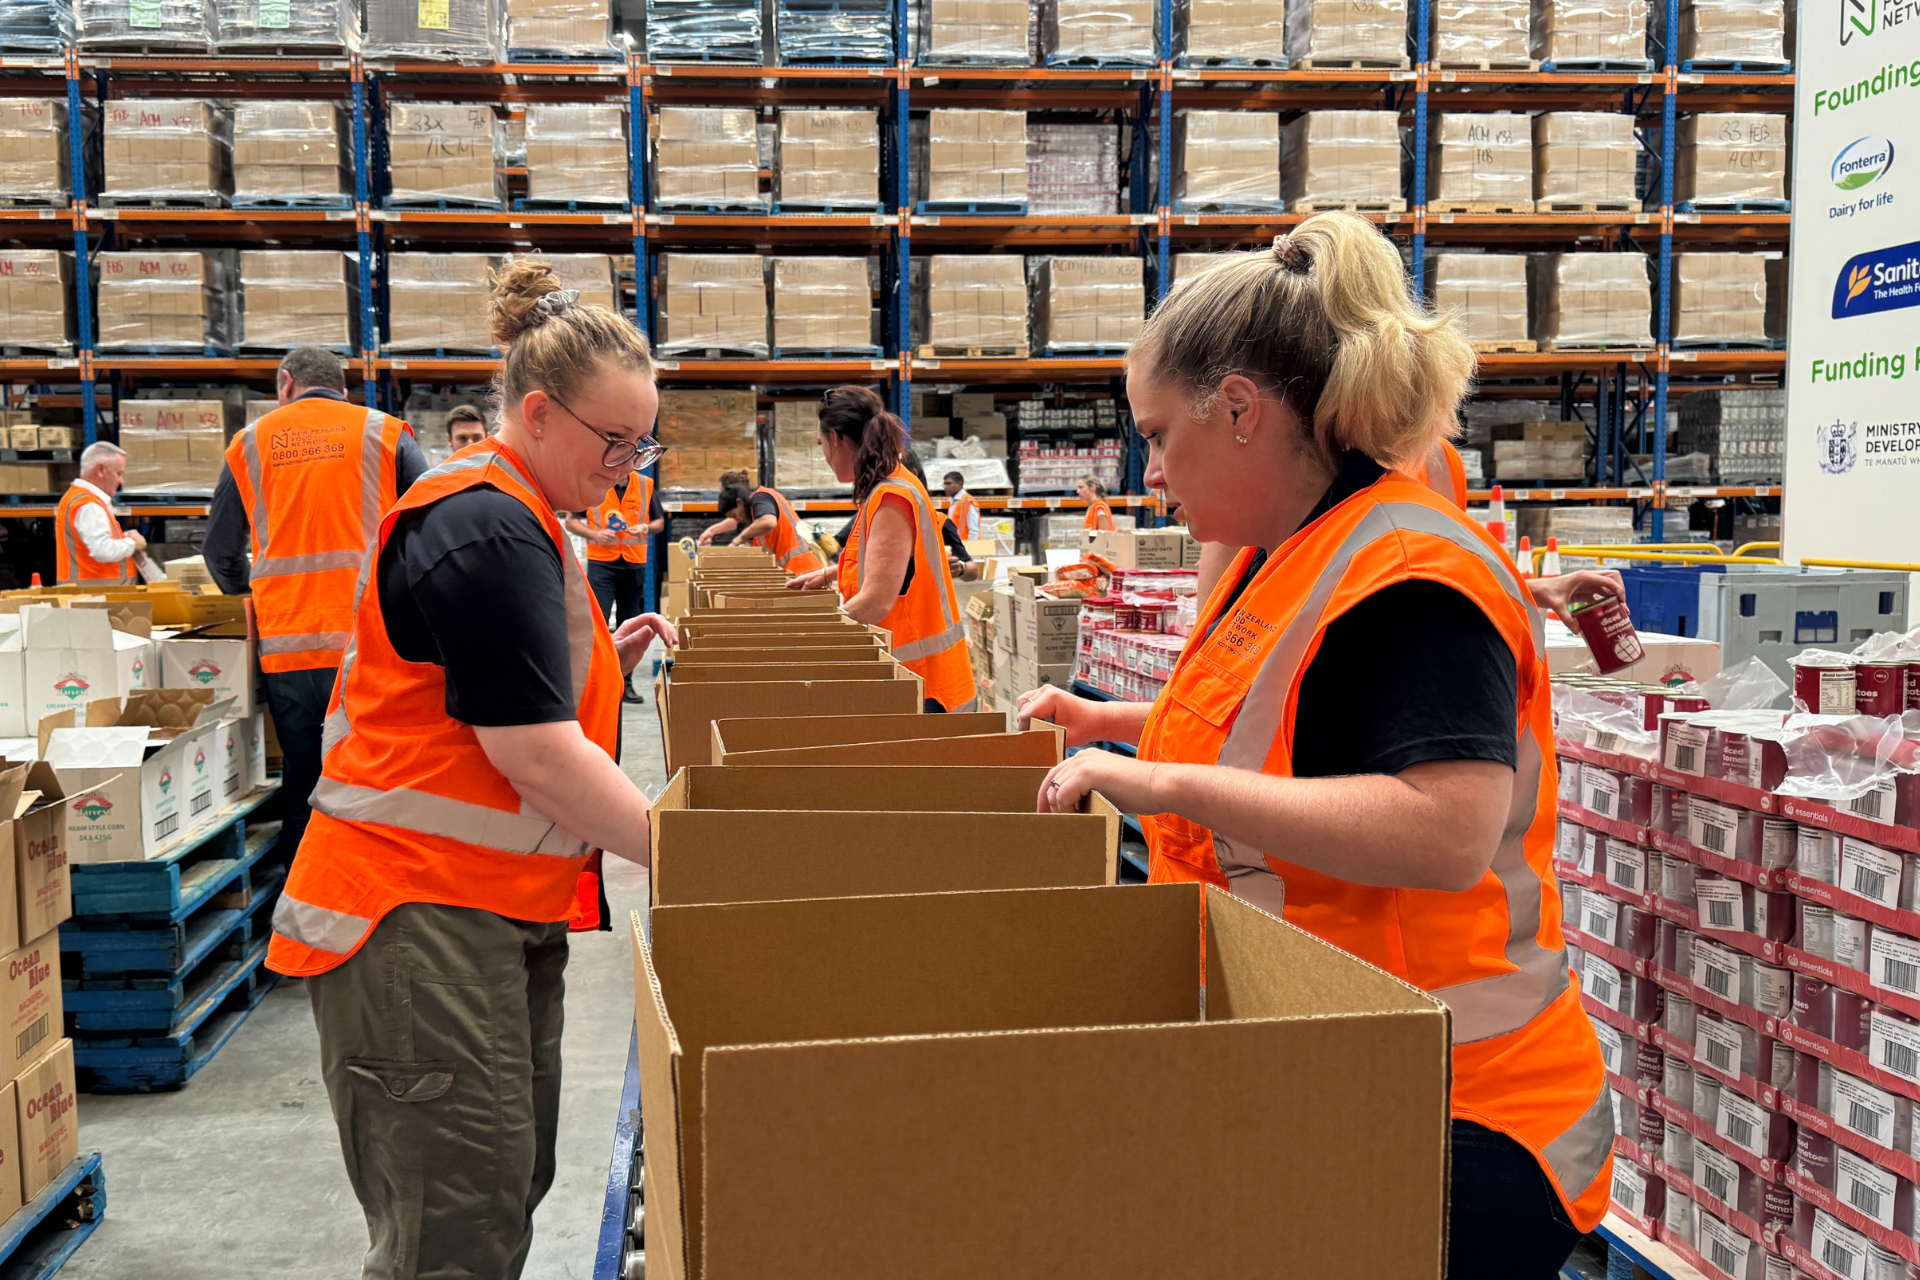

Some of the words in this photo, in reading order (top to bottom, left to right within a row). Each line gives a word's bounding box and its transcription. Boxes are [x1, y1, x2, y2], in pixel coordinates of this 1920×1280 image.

[1467, 124, 1490, 142] ACM
[1839, 151, 1886, 174] Fonterra
[1829, 202, 1856, 219] Dairy
[1858, 198, 1875, 212] for
[1876, 192, 1893, 207] life
[1873, 289, 1888, 300] The
[1889, 284, 1914, 297] Health
[1811, 351, 1905, 384] Funding
[272, 450, 299, 461] 0800
[302, 446, 322, 457] 366
[324, 443, 345, 453] 369
[1865, 458, 1873, 467] TE
[1600, 612, 1622, 627] diced
[1225, 630, 1245, 648] 366
[1795, 807, 1829, 823] essentials
[28, 835, 58, 860] Ocean
[1798, 884, 1831, 900] essentials
[9, 949, 40, 981] Ocean
[1800, 959, 1833, 977] essentials
[28, 963, 51, 990] Blue
[1794, 1035, 1829, 1055] essentials
[1637, 1052, 1658, 1063] diced
[27, 1081, 63, 1119] Ocean
[49, 1093, 74, 1124] Blue
[1640, 1116, 1659, 1127] diced
[1793, 1108, 1828, 1129] essentials
[1765, 1193, 1791, 1206] diced
[1797, 1181, 1831, 1204] essentials
